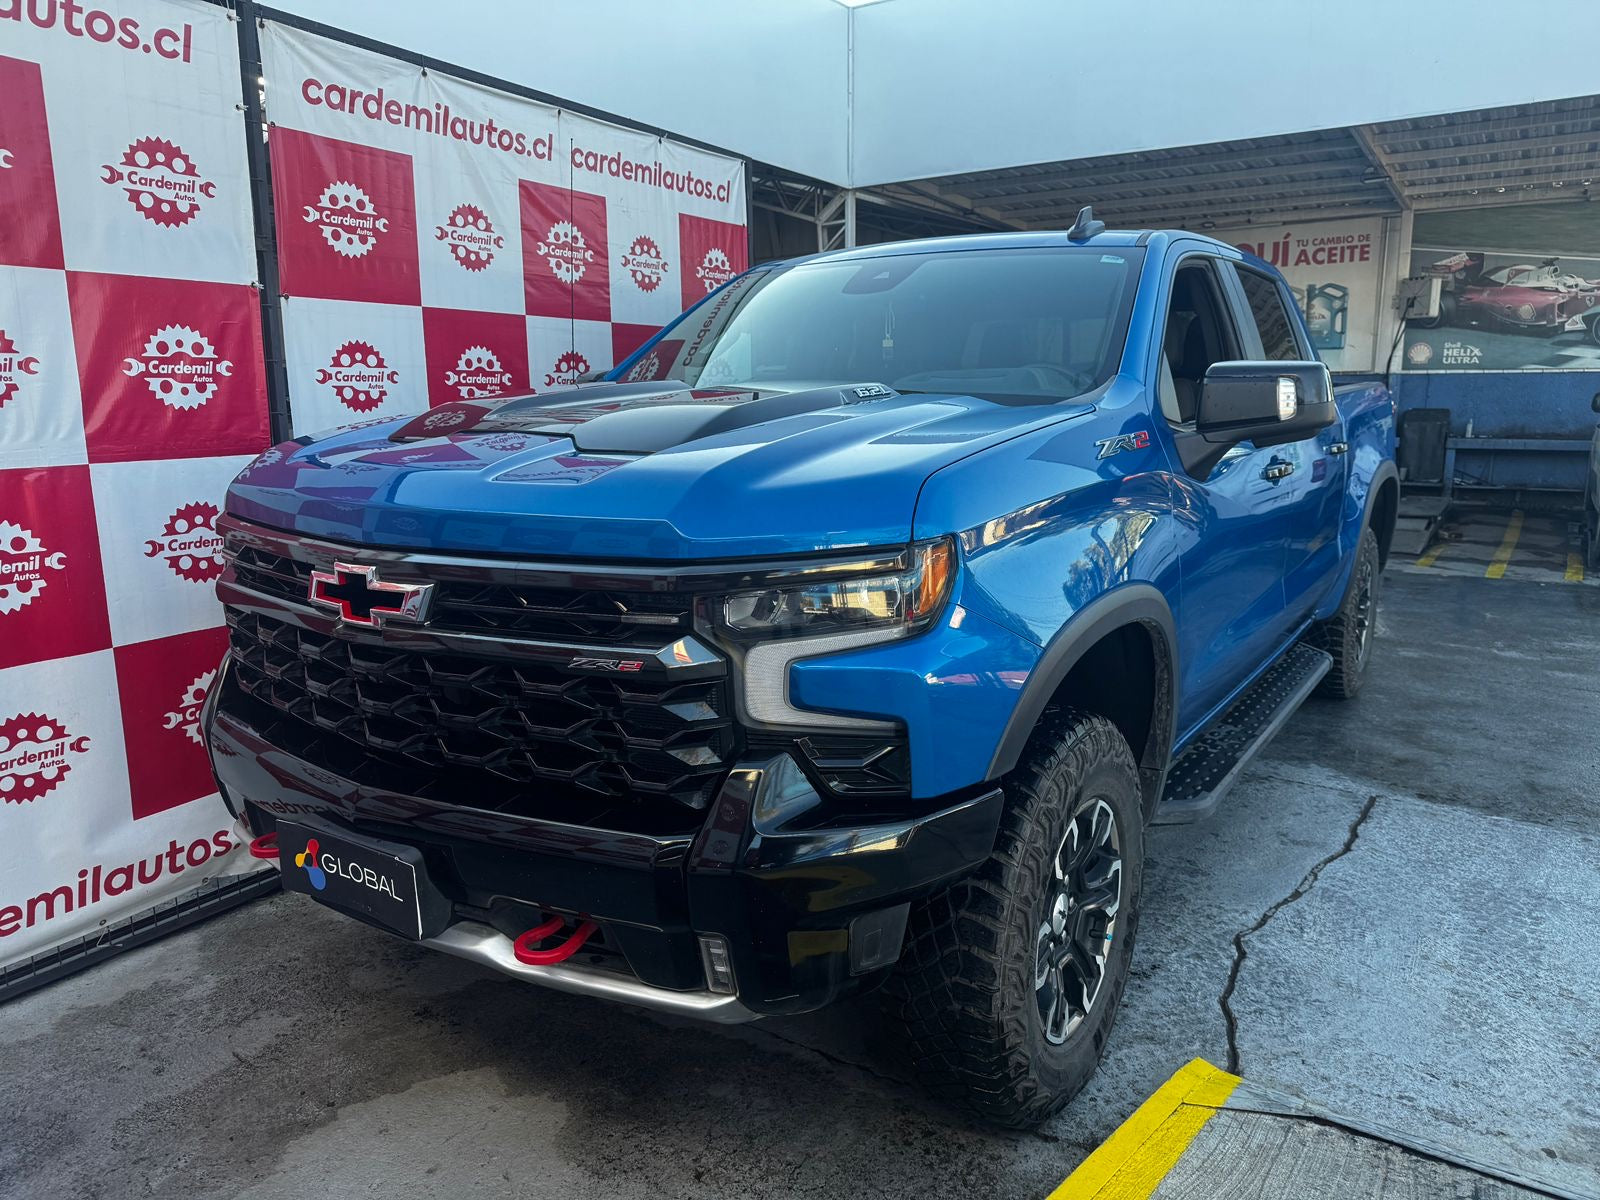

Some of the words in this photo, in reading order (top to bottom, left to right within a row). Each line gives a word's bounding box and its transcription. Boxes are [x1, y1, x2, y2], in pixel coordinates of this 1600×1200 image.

[301, 78, 553, 162] cardemilautos.cl
[127, 170, 196, 194] Cardemil
[571, 147, 731, 203] cardemilautos.cl
[174, 192, 196, 202] Autos
[322, 210, 373, 229] Cardemil
[356, 228, 373, 236] Autos
[450, 229, 492, 246] Cardemil
[1296, 239, 1309, 248] TU
[1312, 235, 1354, 247] CAMBIO
[1358, 233, 1371, 243] DE
[1294, 244, 1371, 267] ACEITE
[631, 258, 660, 271] Cardemil
[1443, 345, 1483, 357] HELIX
[148, 359, 213, 375] Cardemil
[1442, 356, 1480, 365] ULTRA
[192, 375, 213, 383] Autos
[334, 370, 384, 383] Cardemil
[460, 372, 500, 384] Cardemil
[1094, 430, 1151, 460] ZR2
[0, 555, 40, 574] emil
[13, 573, 41, 582] Autos
[39, 758, 65, 770] Autos
[321, 852, 404, 903] GLOBAL
